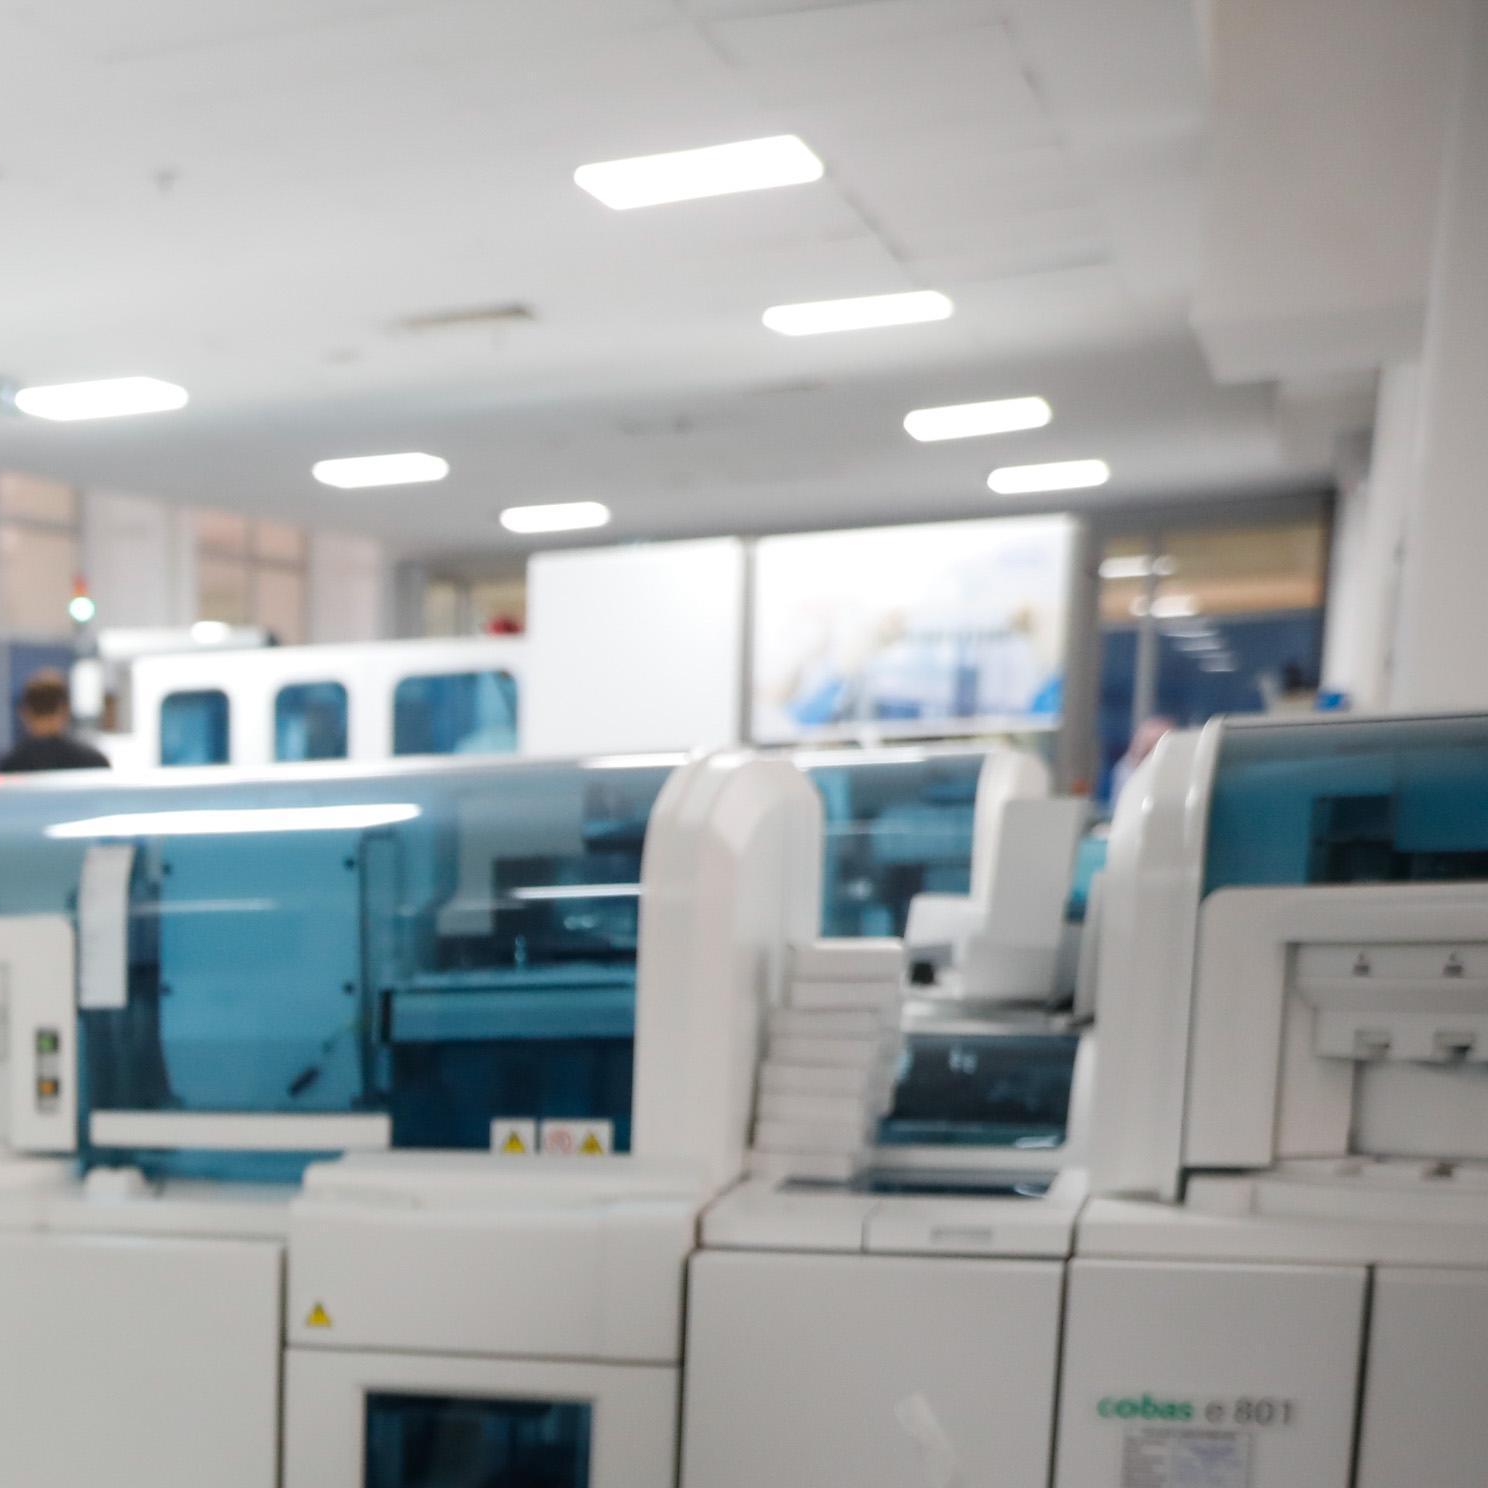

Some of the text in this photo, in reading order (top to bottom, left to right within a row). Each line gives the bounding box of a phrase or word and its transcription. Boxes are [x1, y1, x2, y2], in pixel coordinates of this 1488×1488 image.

[1096, 1392, 1294, 1426] cobas e 801
